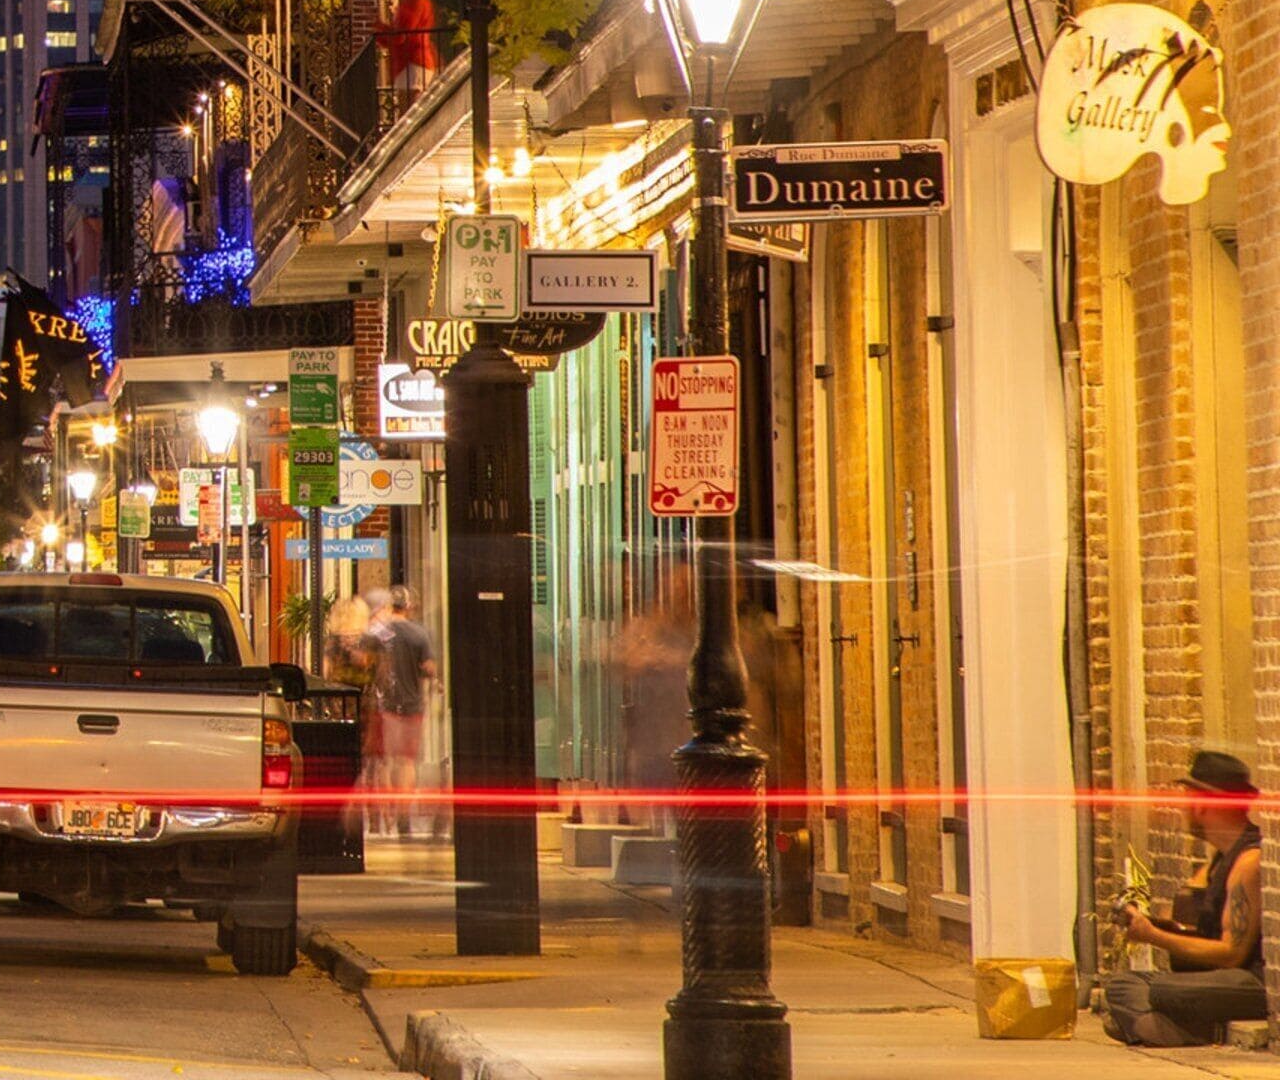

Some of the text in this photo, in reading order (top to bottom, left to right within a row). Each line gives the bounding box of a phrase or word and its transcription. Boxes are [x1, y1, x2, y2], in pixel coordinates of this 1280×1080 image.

[1071, 35, 1147, 78] Mk
[1066, 90, 1157, 143] Gallery
[788, 147, 889, 161] Rue Dumaine
[746, 167, 934, 205] Dumaine
[471, 256, 497, 267] PAY
[474, 273, 493, 284] TO
[540, 275, 618, 288] GALLERY
[465, 288, 502, 299] PARK
[292, 350, 335, 361] PAY TO
[296, 362, 330, 371] PARK
[656, 372, 734, 400] NO STOPPING
[667, 433, 724, 448] THURSDAY
[294, 451, 334, 463] 29303
[674, 450, 717, 464] STREET
[664, 466, 726, 480] CLEANING
[297, 544, 376, 553] EAING LADY
